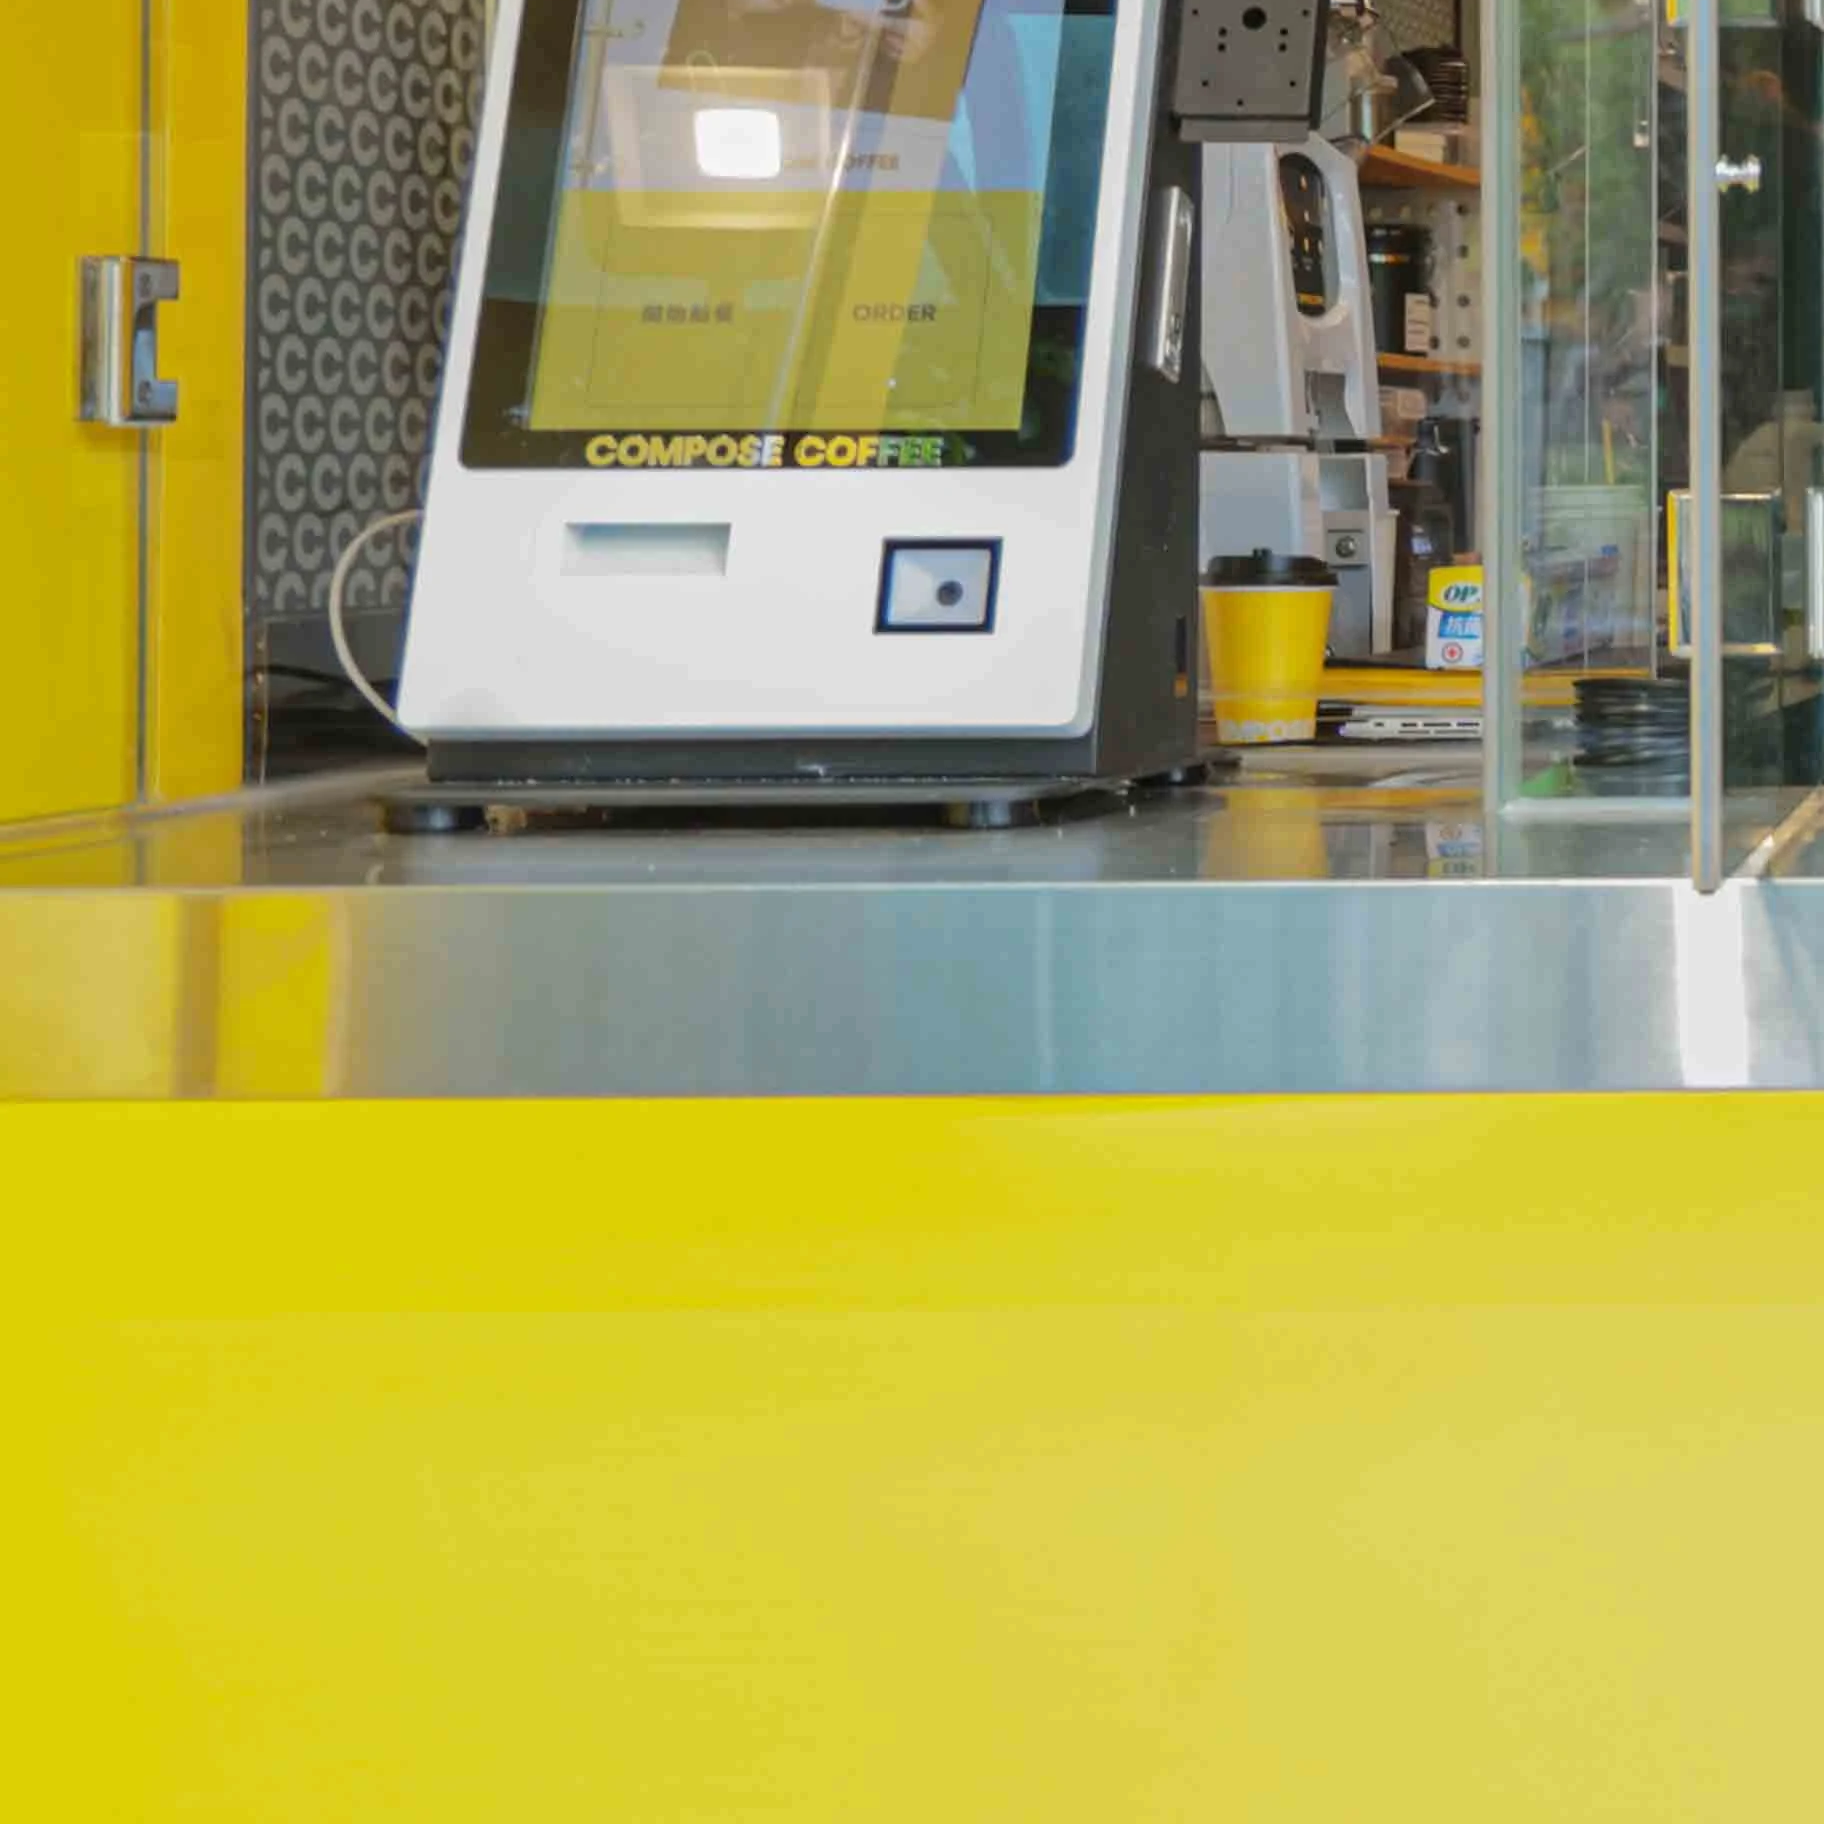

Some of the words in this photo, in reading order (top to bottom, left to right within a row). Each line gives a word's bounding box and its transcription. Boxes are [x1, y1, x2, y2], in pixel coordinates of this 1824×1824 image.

[853, 304, 937, 322] ORDER
[585, 434, 785, 468] COMPOSE
[794, 434, 944, 468] COFFEE
